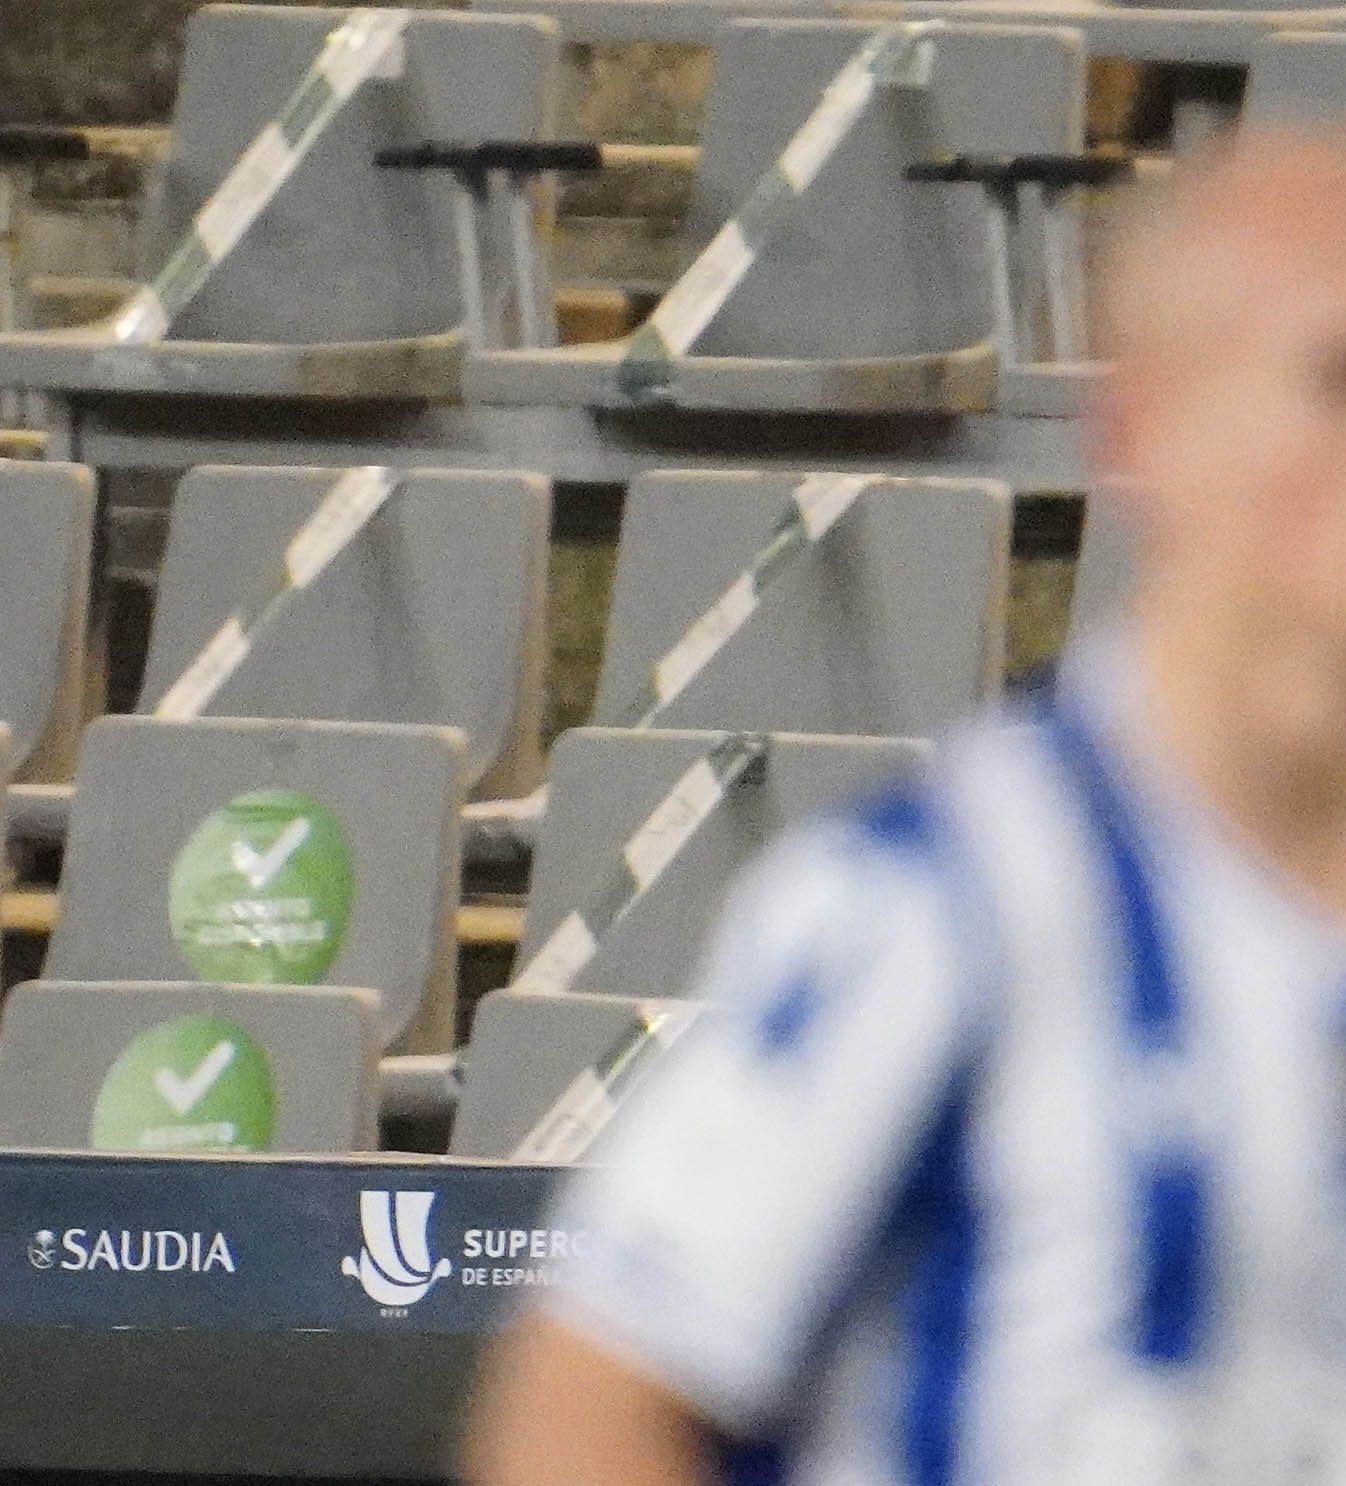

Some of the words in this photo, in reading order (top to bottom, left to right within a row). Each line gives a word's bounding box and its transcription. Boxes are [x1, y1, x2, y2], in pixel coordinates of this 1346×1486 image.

[60, 1227, 236, 1273] SAUDIA
[463, 1229, 590, 1258] SUPERC
[462, 1267, 488, 1286] DE
